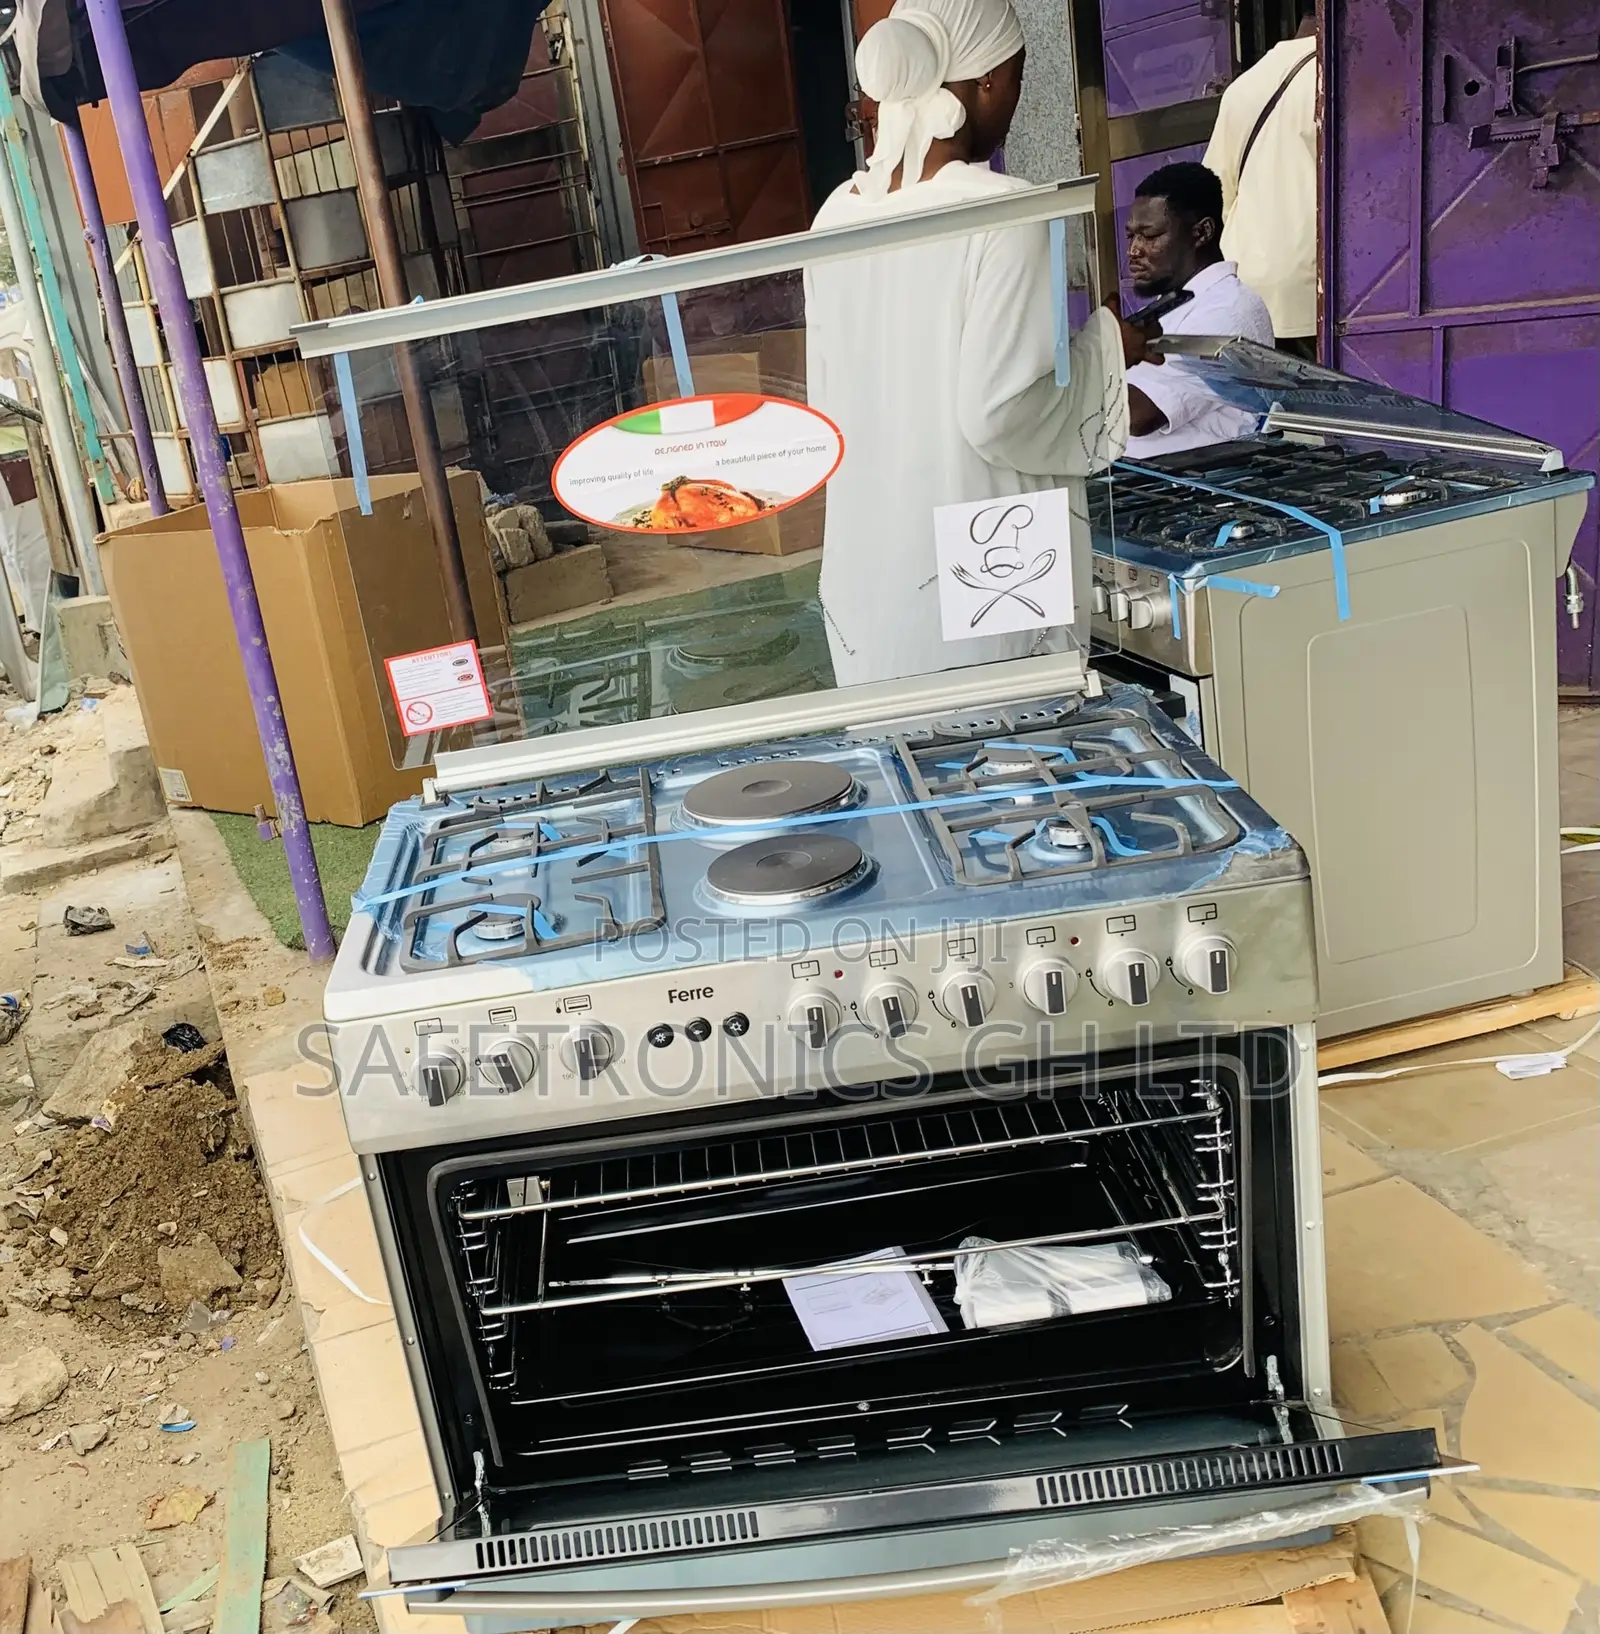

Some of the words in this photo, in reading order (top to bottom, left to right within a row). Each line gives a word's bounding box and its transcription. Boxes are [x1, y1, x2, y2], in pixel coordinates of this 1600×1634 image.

[721, 453, 756, 466] beautifull
[757, 451, 777, 461] piece
[778, 449, 786, 458] of
[787, 448, 804, 457] your
[805, 444, 827, 454] home
[569, 474, 606, 486] improving
[607, 470, 632, 481] quality
[633, 468, 641, 477] of
[642, 467, 654, 476] life
[668, 986, 714, 1004] Ferre
